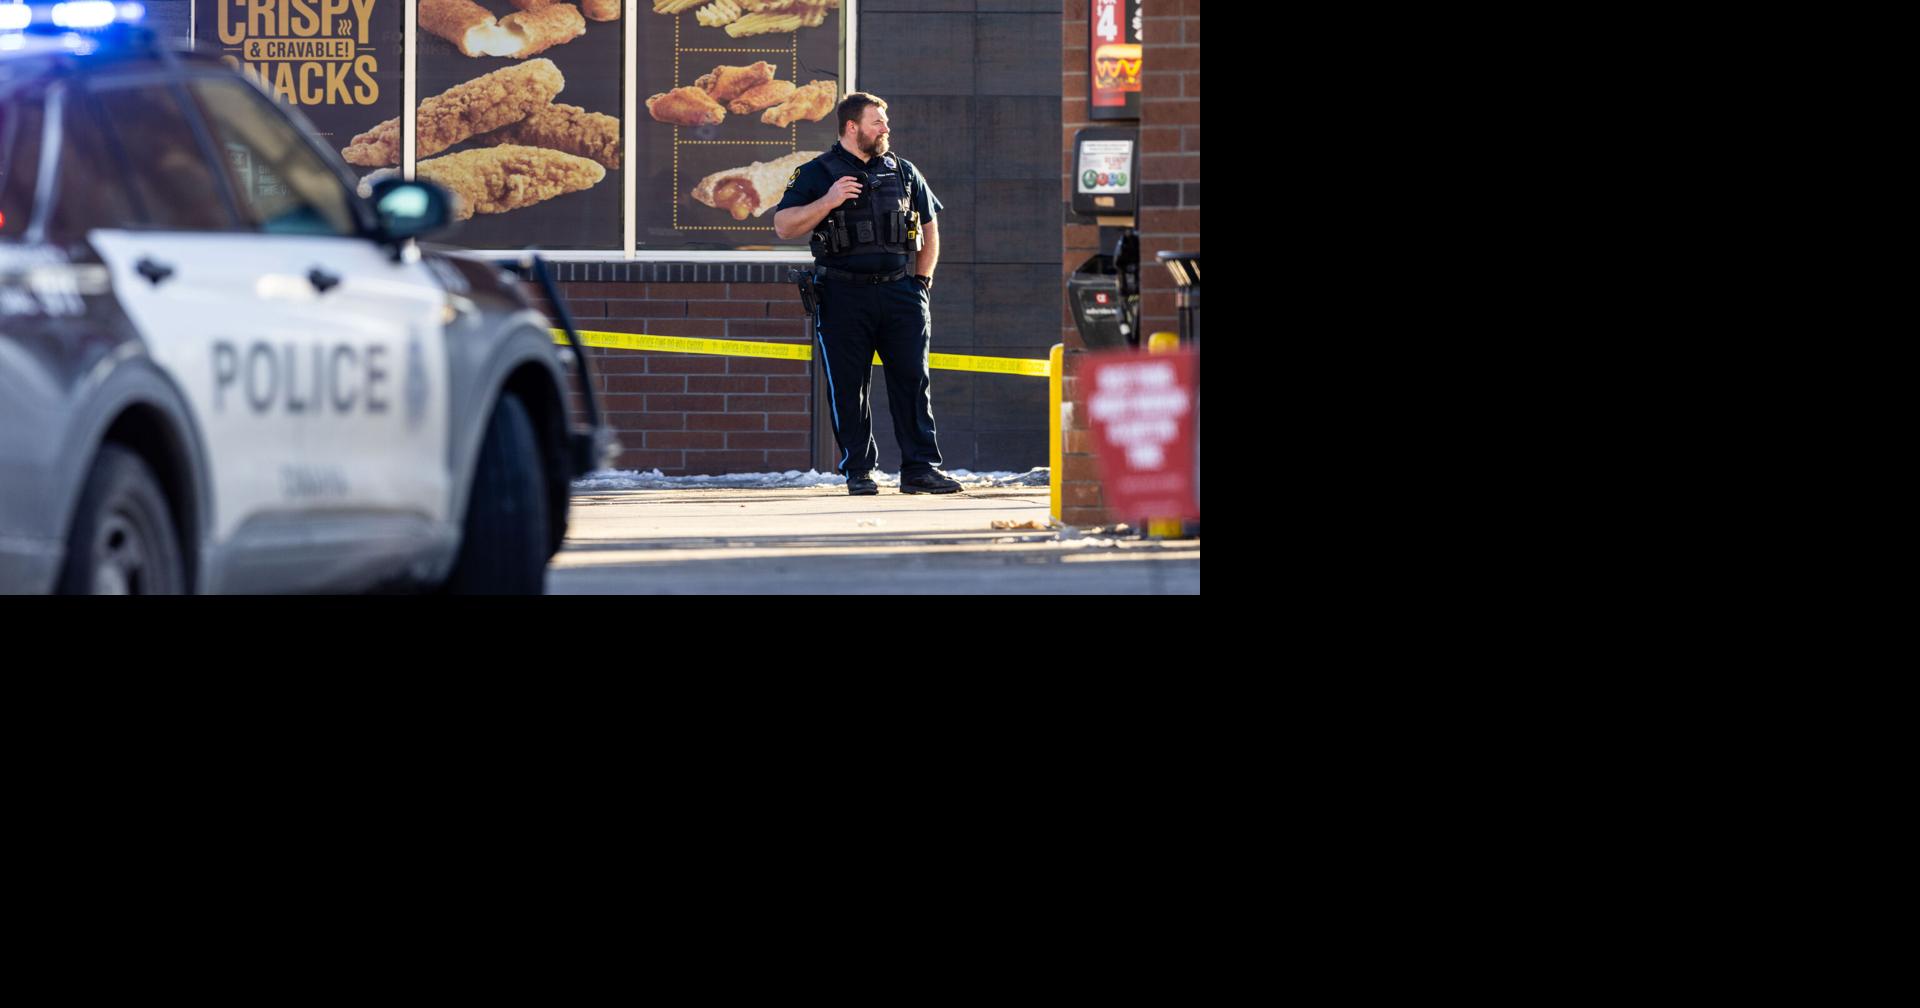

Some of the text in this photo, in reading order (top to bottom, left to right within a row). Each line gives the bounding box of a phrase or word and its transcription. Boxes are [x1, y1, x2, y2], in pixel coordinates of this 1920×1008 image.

[218, 0, 376, 45] CRISPY
[250, 41, 349, 57] & CRAVABLE!
[221, 55, 379, 105] NACKS
[212, 341, 389, 414] POLICE
